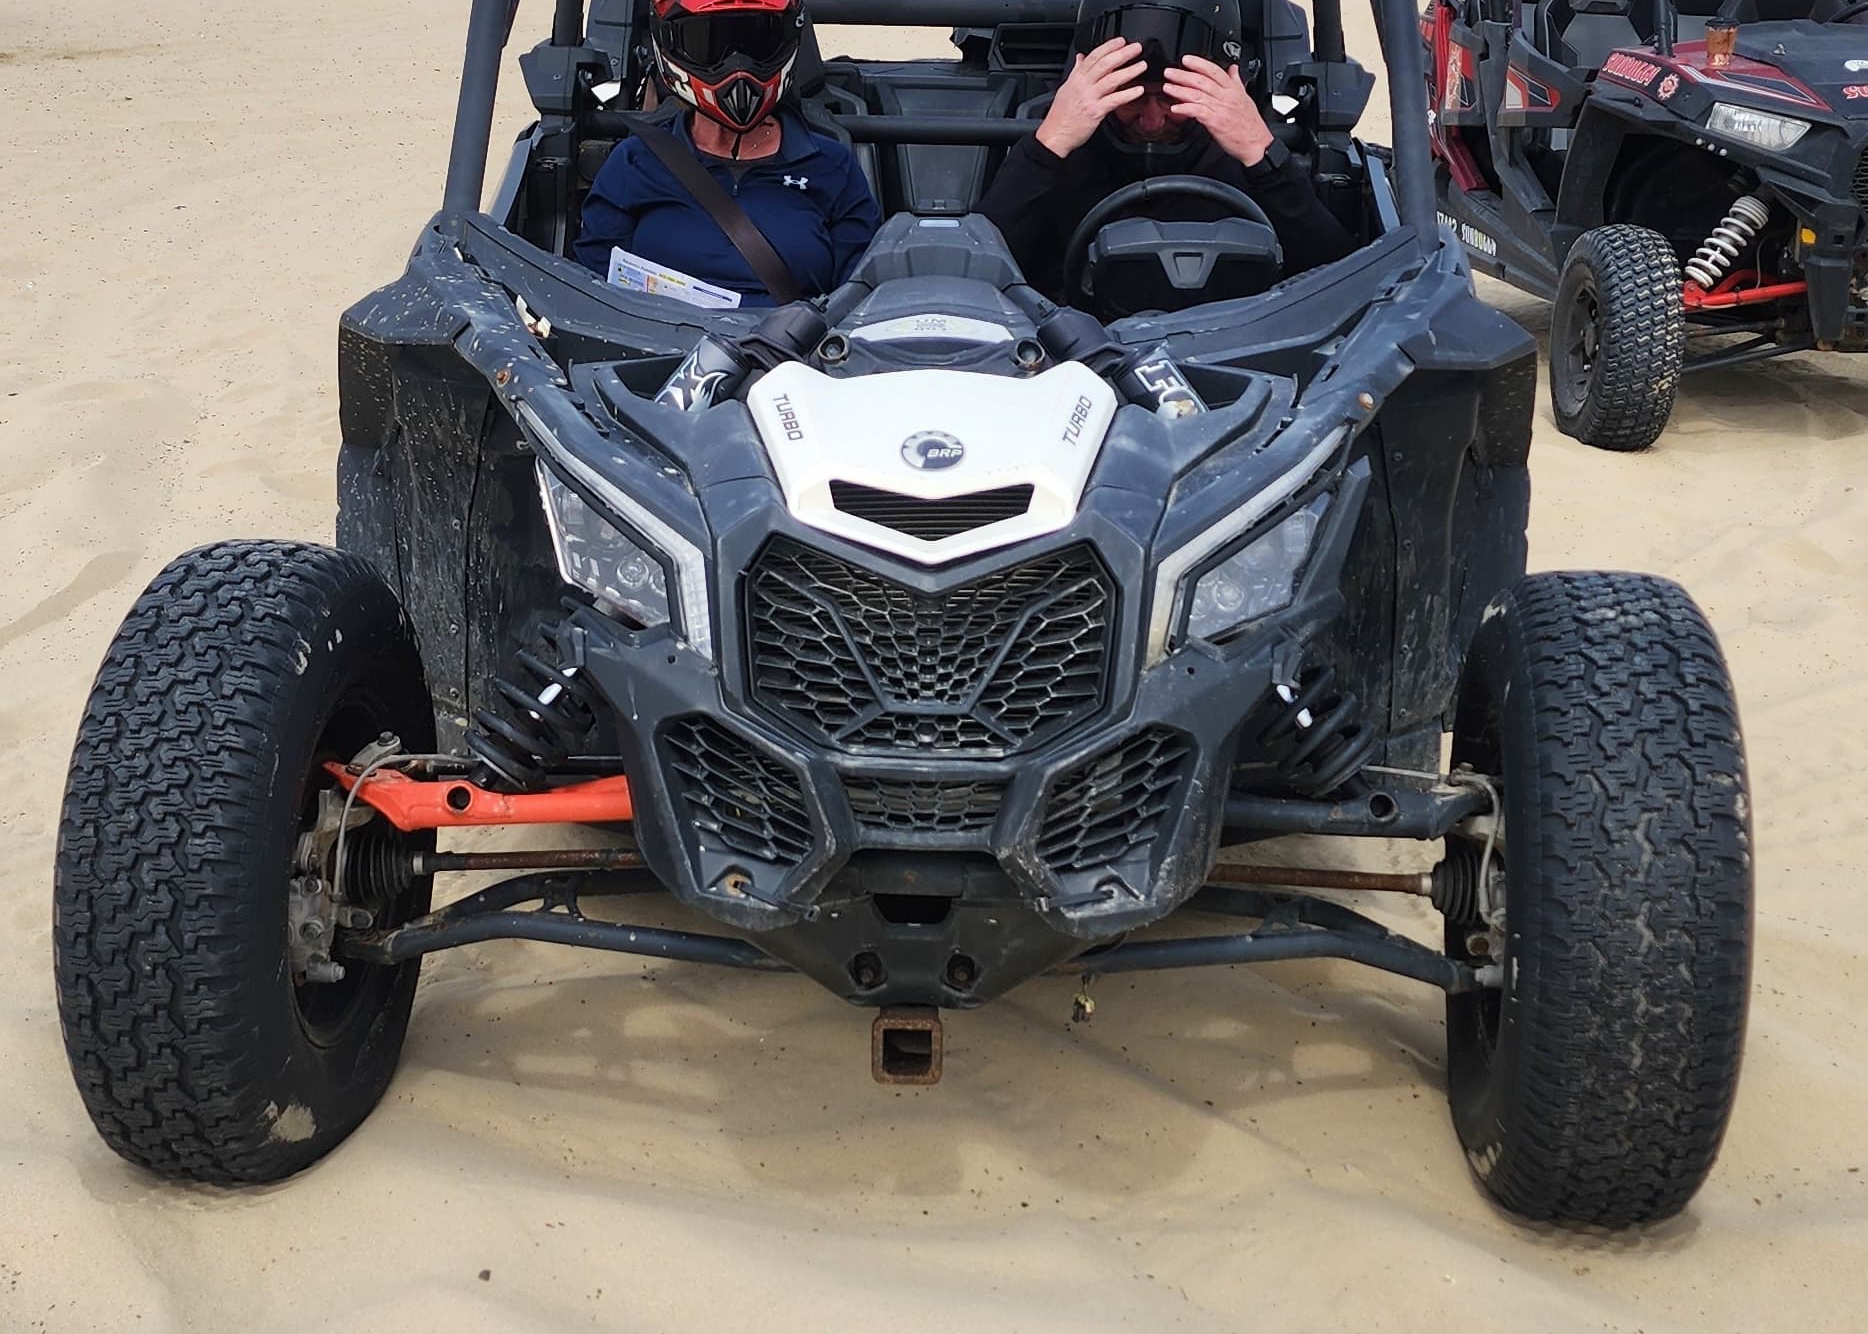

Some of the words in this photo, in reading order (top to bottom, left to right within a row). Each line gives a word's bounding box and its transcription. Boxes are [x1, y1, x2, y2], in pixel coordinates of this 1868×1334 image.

[772, 393, 803, 440] TURBO
[1062, 395, 1093, 446] TURBO
[926, 447, 963, 460] BRP
